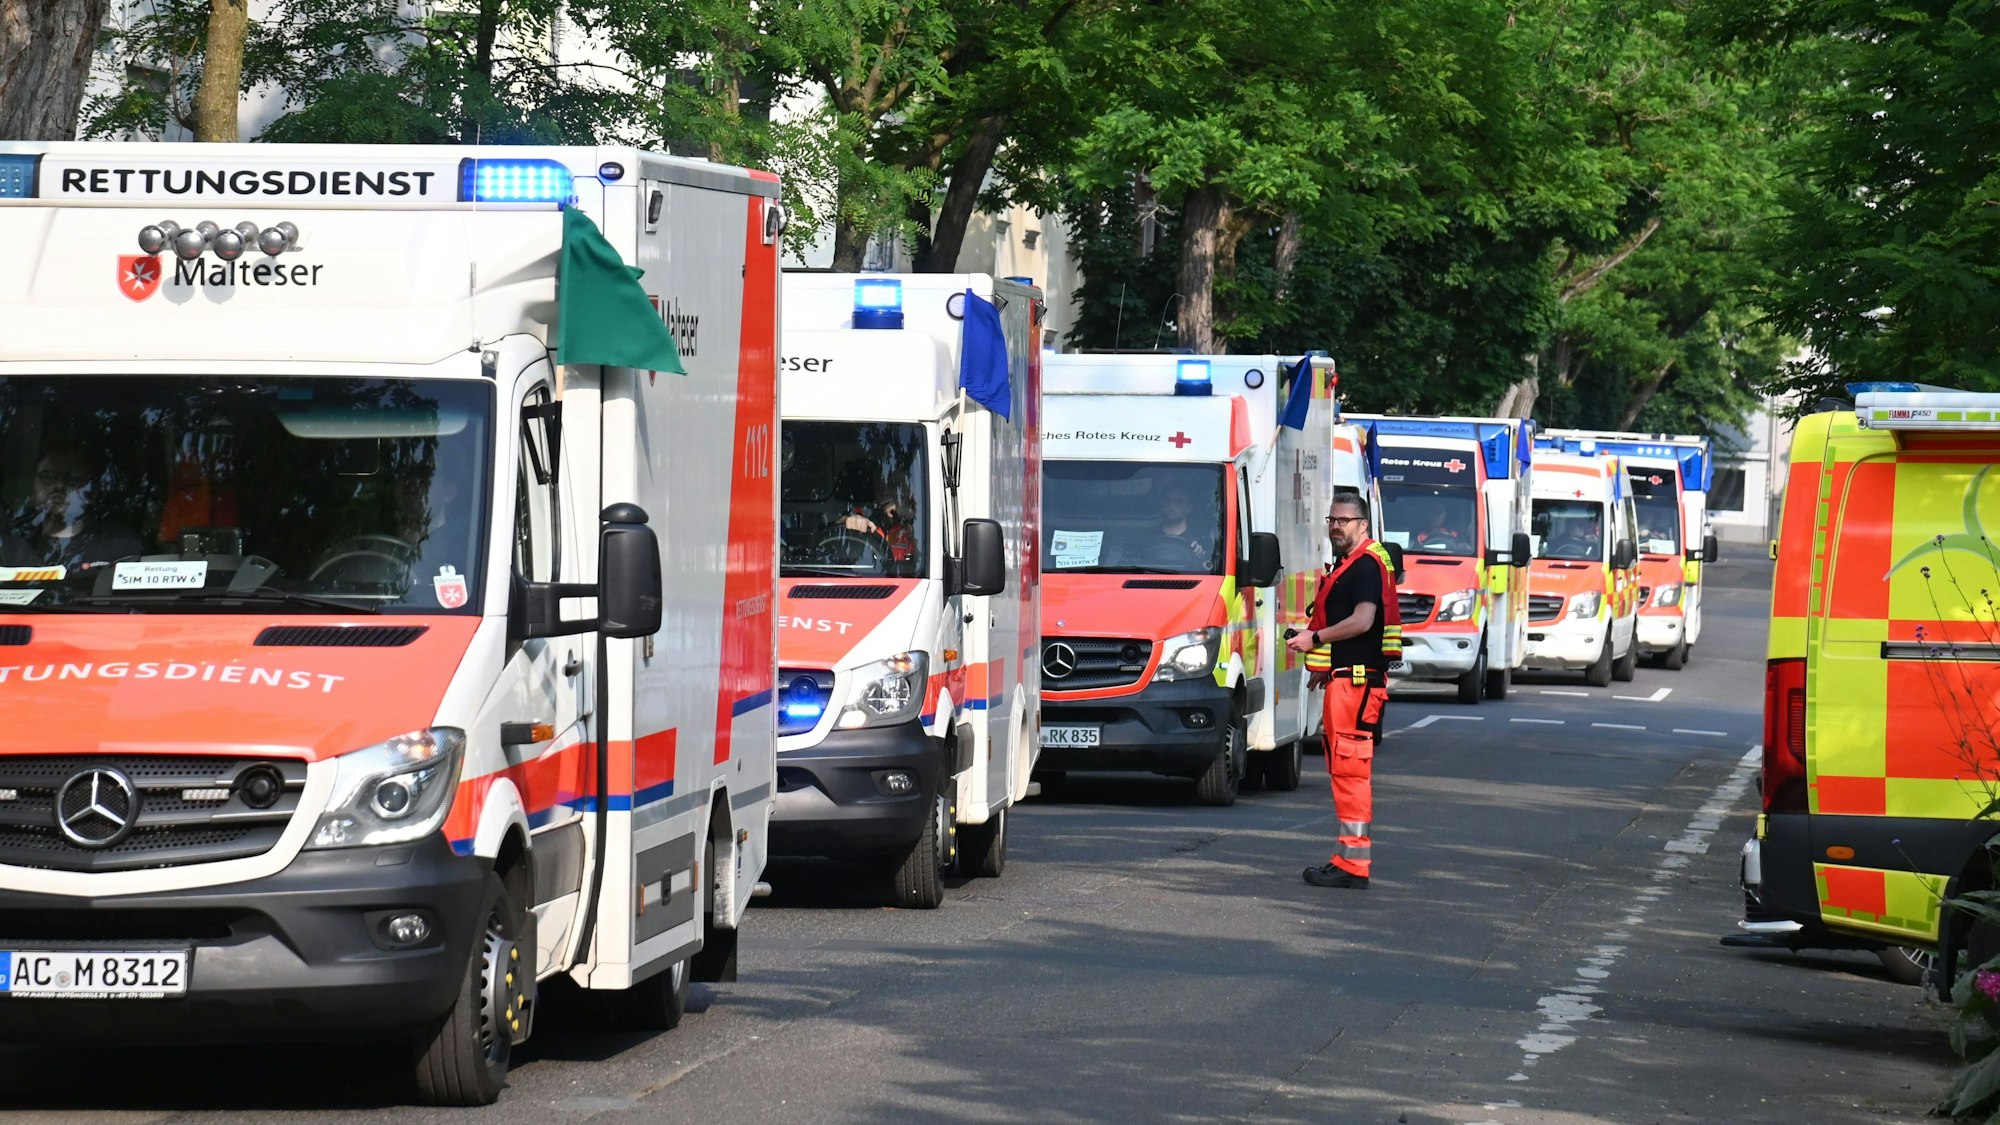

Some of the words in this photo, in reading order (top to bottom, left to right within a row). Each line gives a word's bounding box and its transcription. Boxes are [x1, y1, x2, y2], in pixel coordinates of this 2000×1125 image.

[62, 168, 435, 195] RETTUNGSDIENST
[174, 257, 323, 286] Malteser
[1888, 410, 1910, 419] FIAMMA
[1075, 430, 1116, 440] Rotes
[1120, 431, 1161, 442] Kreuz
[1380, 457, 1410, 466] Rotes
[1412, 459, 1443, 468] Kreuz
[122, 576, 142, 584] SIM
[162, 575, 187, 583] RTW
[190, 575, 196, 583] 6
[0, 662, 345, 693] TUNGSDIENST
[1049, 729, 1068, 743] RK
[1071, 729, 1097, 743] 835
[14, 957, 51, 986] AC
[75, 958, 93, 986] M
[102, 958, 179, 986] 8312
